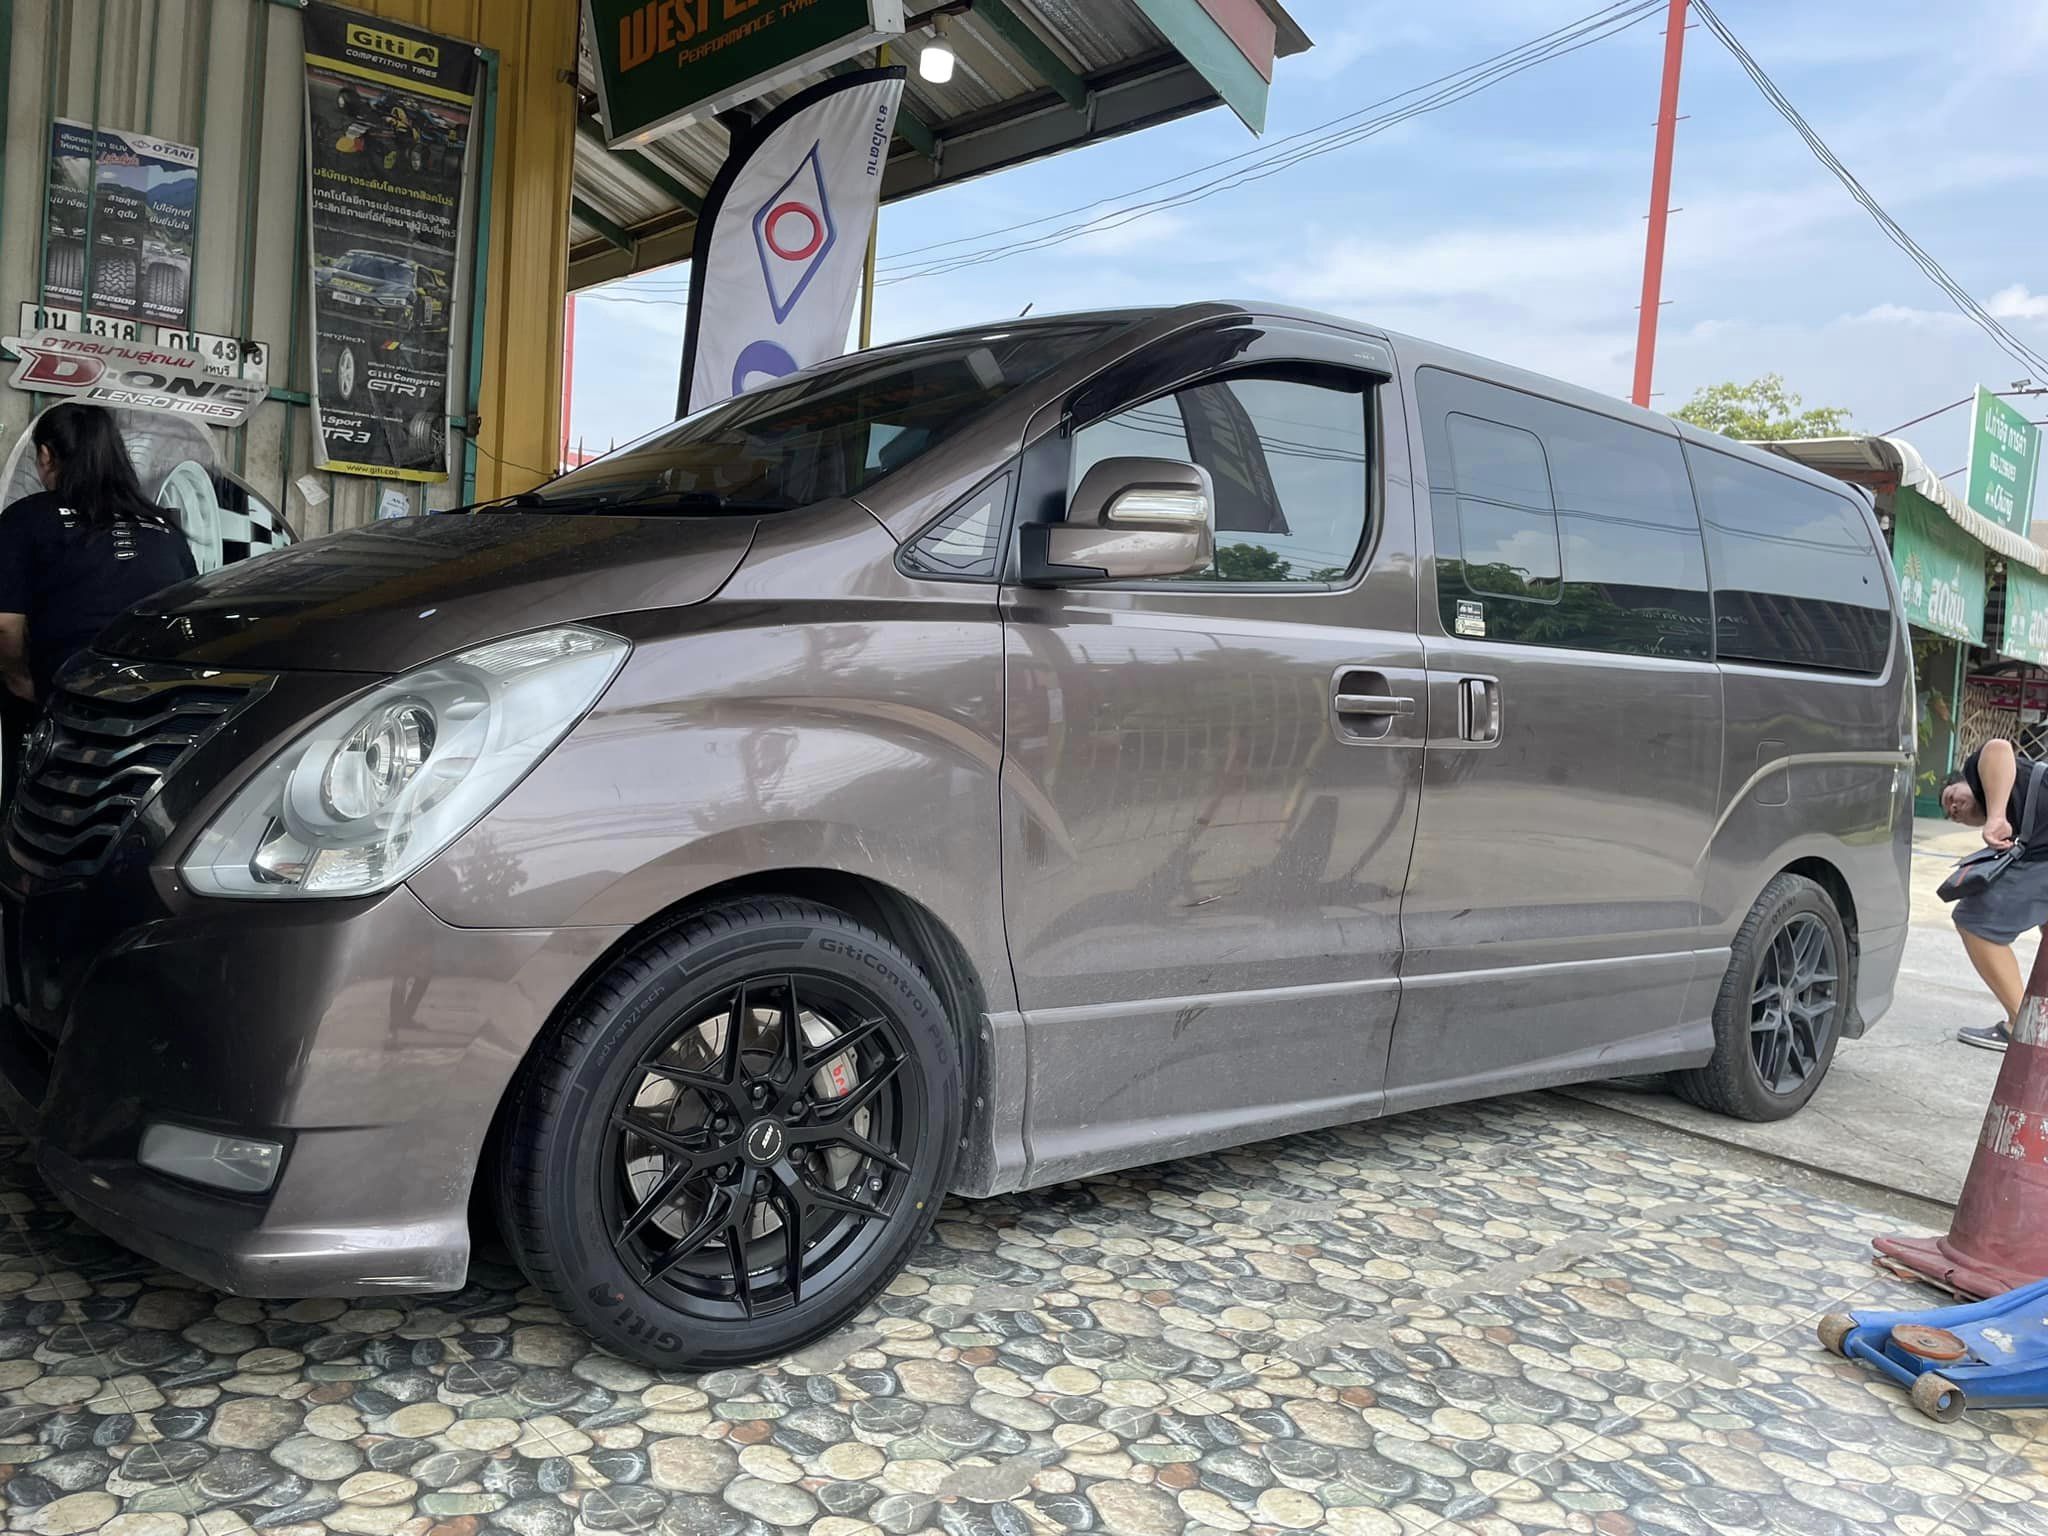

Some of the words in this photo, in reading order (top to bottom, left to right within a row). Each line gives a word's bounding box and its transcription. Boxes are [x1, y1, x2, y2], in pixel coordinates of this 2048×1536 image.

[353, 31, 405, 56] Giti
[678, 10, 776, 69] PERFORMANCE
[412, 65, 438, 79] TIRES
[152, 144, 195, 161] OTANI
[41, 336, 196, 370] จากสนามสู่ถนน
[393, 371, 441, 388] Compete
[92, 387, 170, 408] LENSO
[174, 400, 244, 419] TIRES
[327, 415, 362, 428] Sport
[320, 426, 372, 444] TR3
[818, 937, 929, 1019] GitiControl
[613, 1306, 684, 1353] Giti
